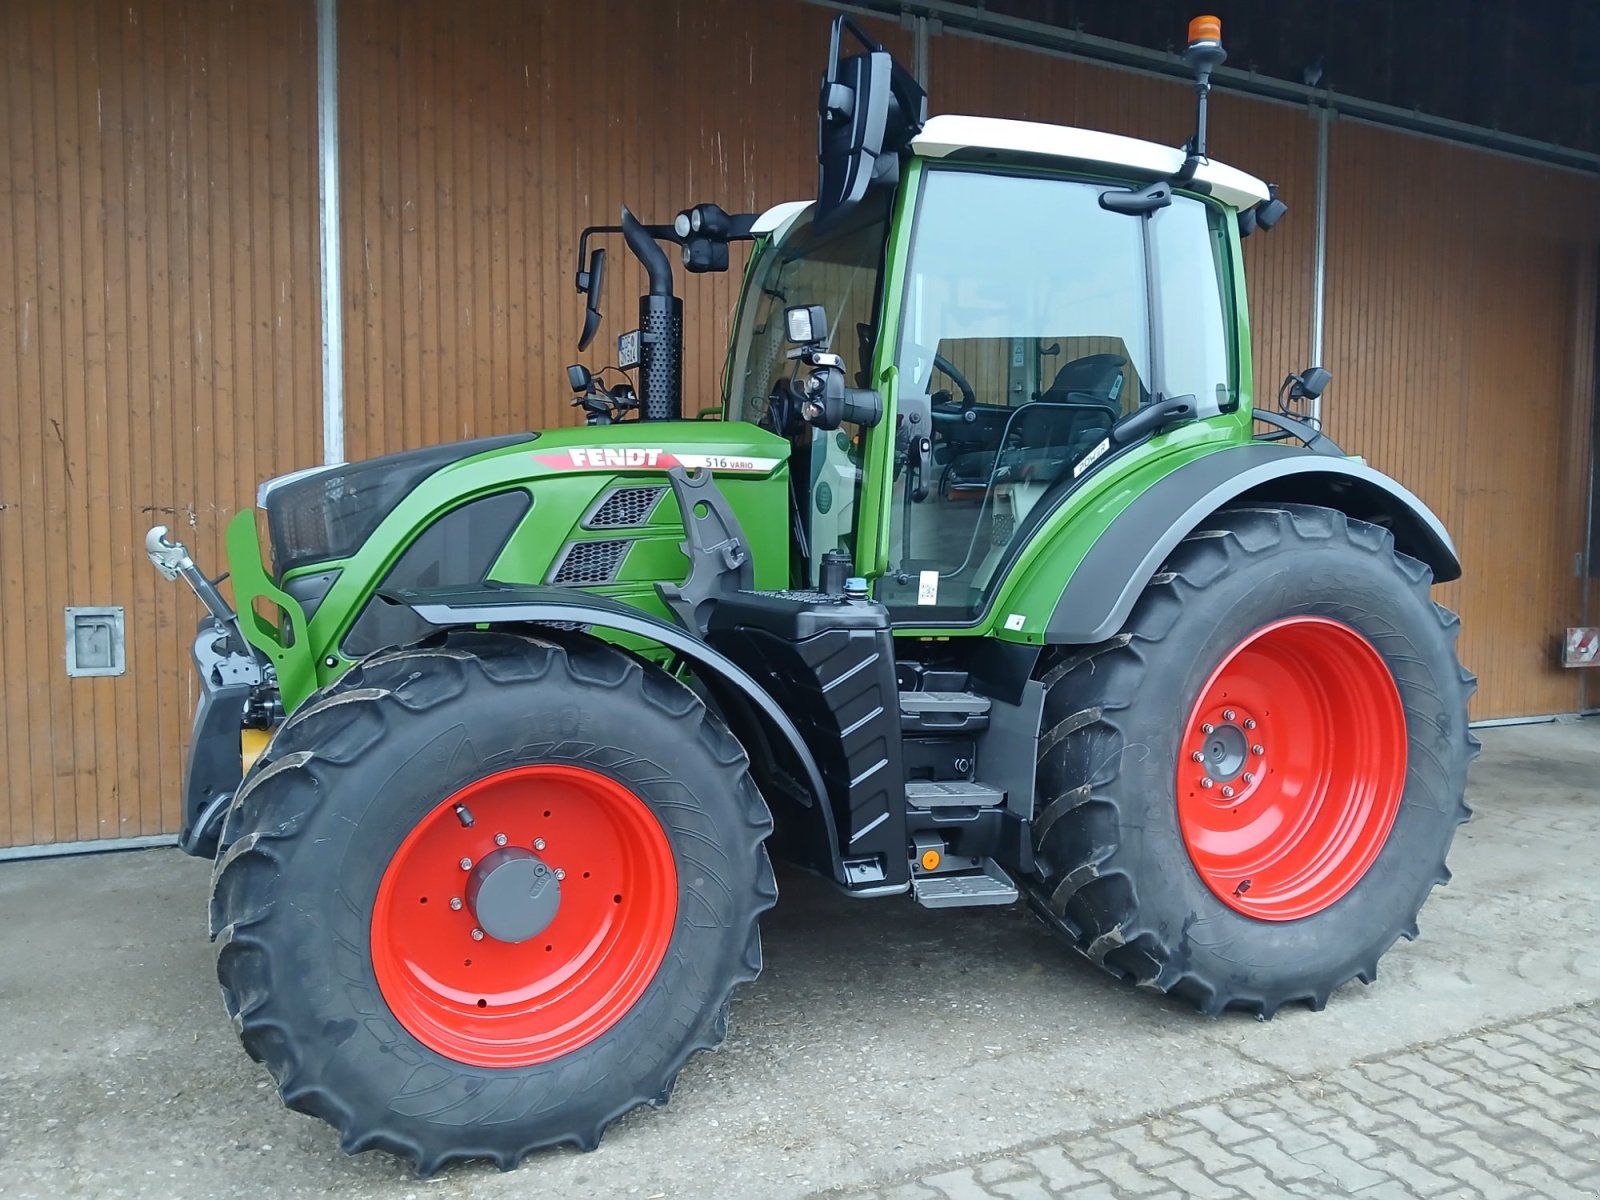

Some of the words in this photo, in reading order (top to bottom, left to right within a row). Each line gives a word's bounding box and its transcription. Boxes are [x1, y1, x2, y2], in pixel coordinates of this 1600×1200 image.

[568, 448, 663, 467] FENDT
[705, 457, 727, 468] 516
[729, 461, 754, 469] VARIO
[1079, 443, 1106, 472] POWER
